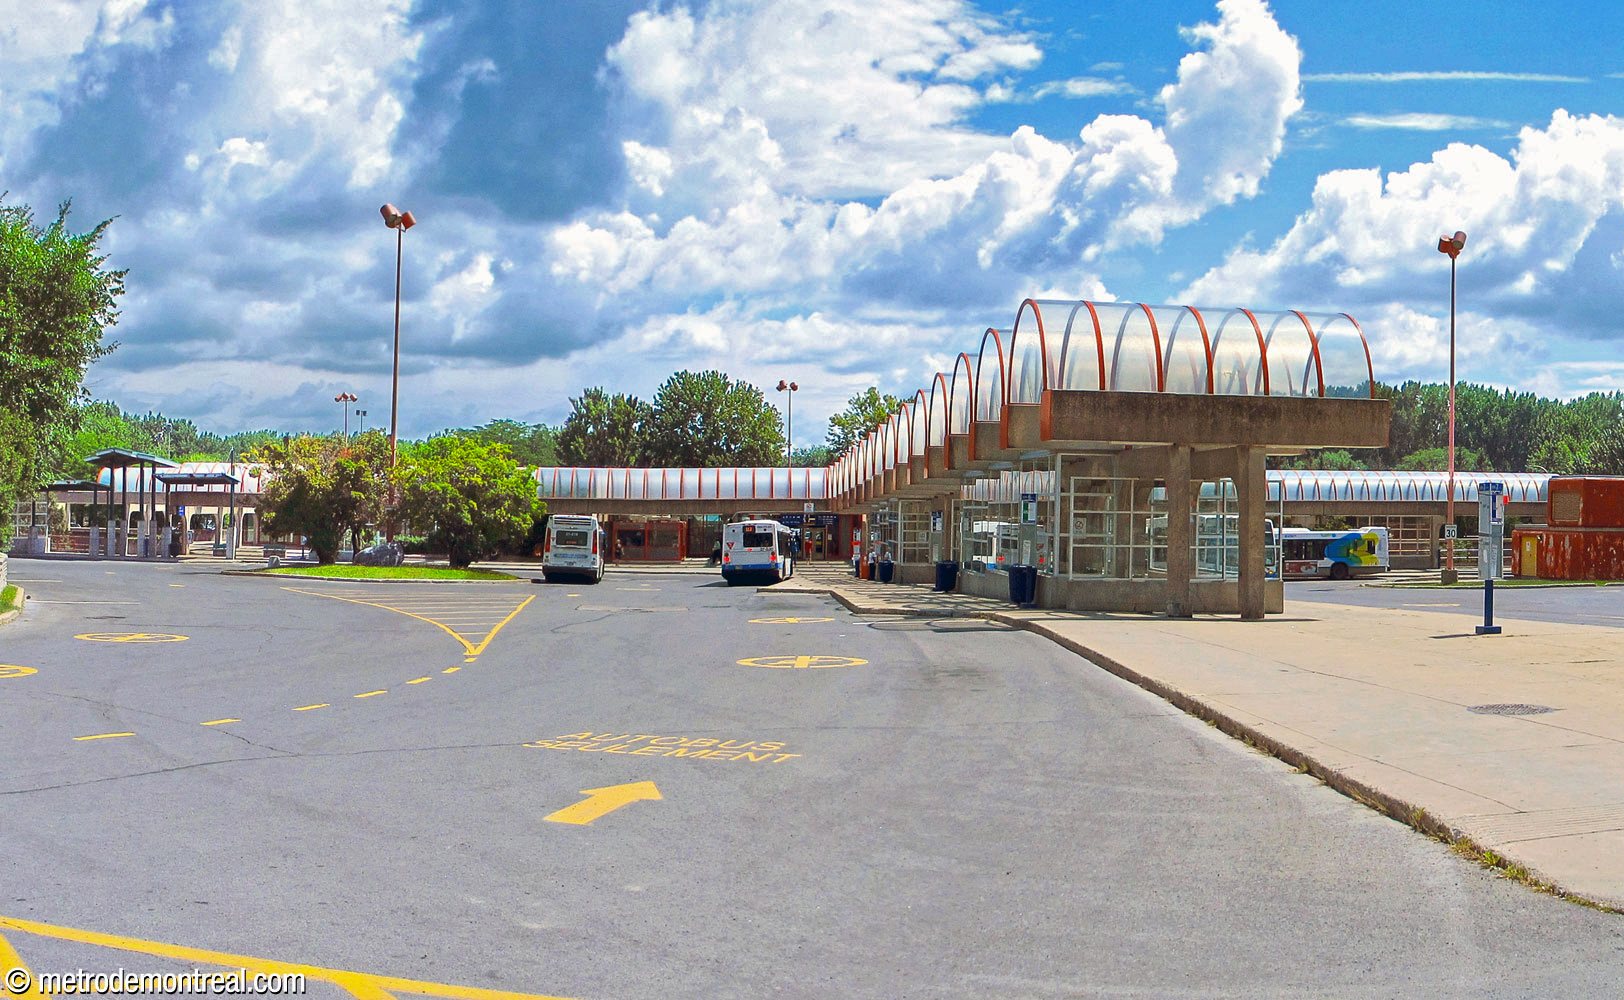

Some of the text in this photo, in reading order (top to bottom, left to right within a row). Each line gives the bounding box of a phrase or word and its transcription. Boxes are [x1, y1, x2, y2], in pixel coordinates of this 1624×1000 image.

[1446, 529, 1456, 538] 30
[556, 732, 786, 751] AUTOBUS
[522, 740, 802, 763] SEULEMENT
